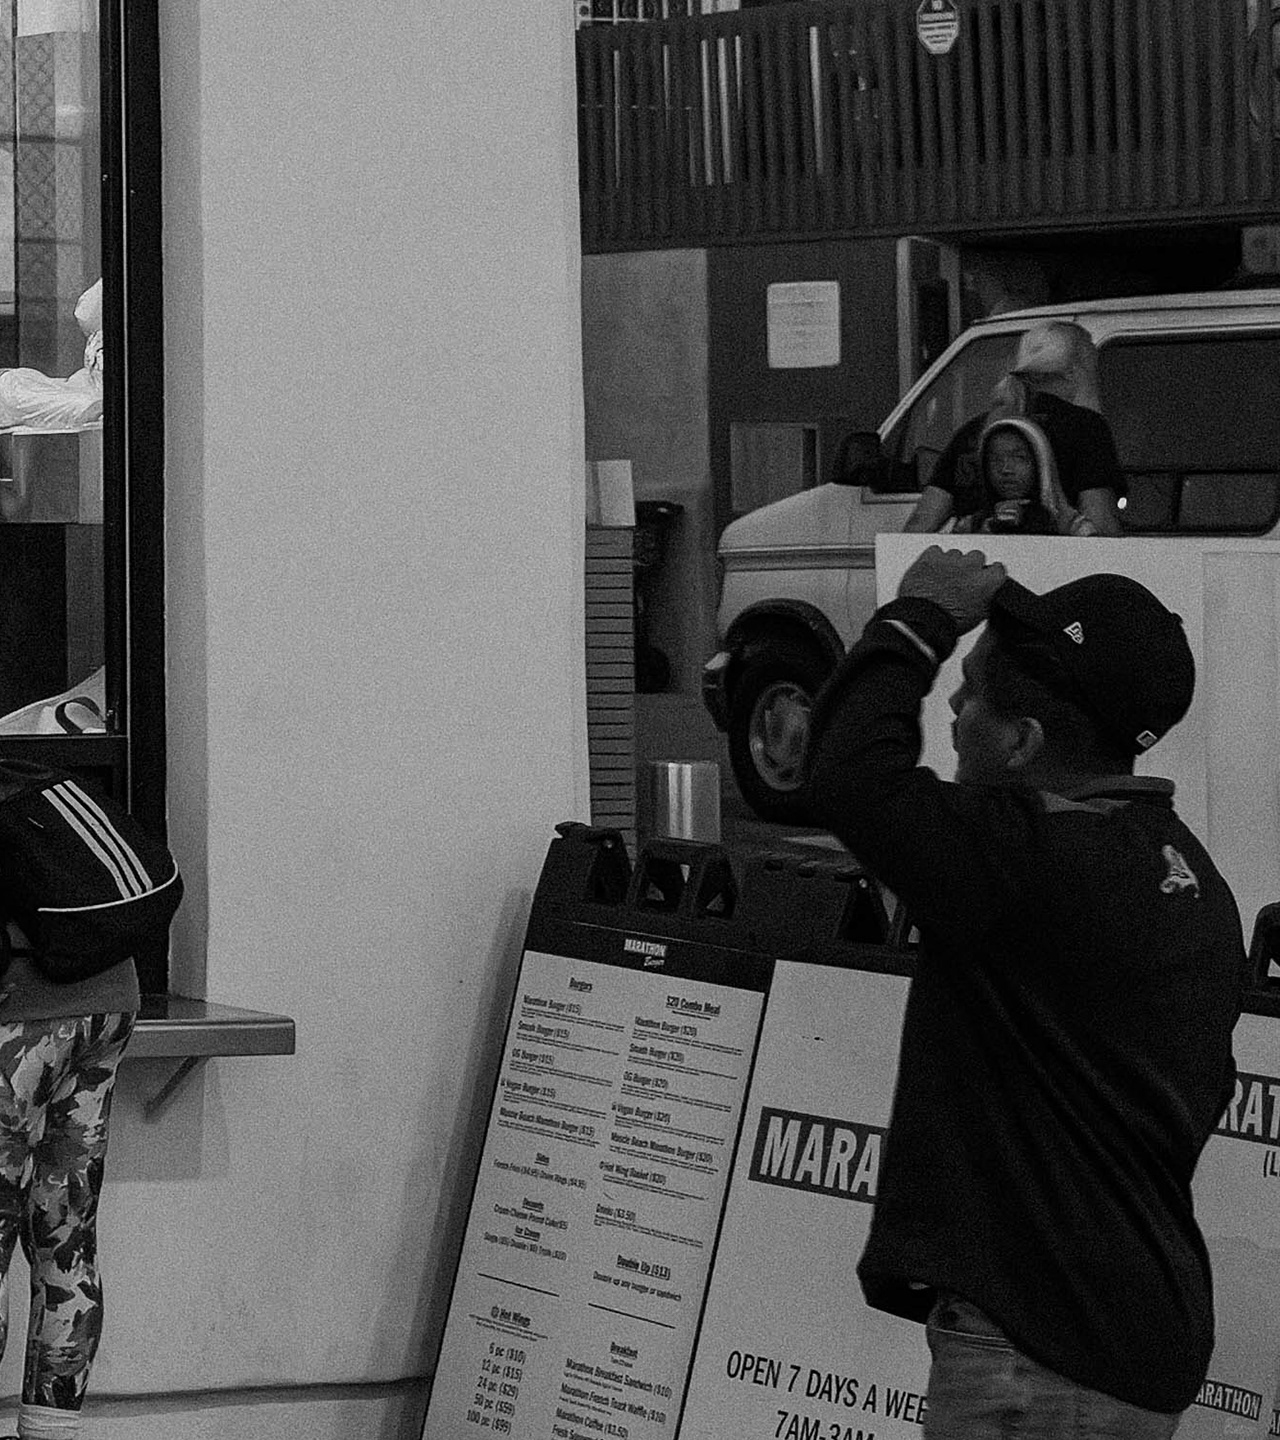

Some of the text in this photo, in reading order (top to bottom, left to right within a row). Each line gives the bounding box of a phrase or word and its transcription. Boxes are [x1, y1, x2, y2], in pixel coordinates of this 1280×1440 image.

[759, 1115, 882, 1197] MARA
[482, 1359, 491, 1372] 12
[726, 1350, 928, 1425] OPEN 7 DAYS A WEE
[1195, 1383, 1260, 1418] ARATHON
